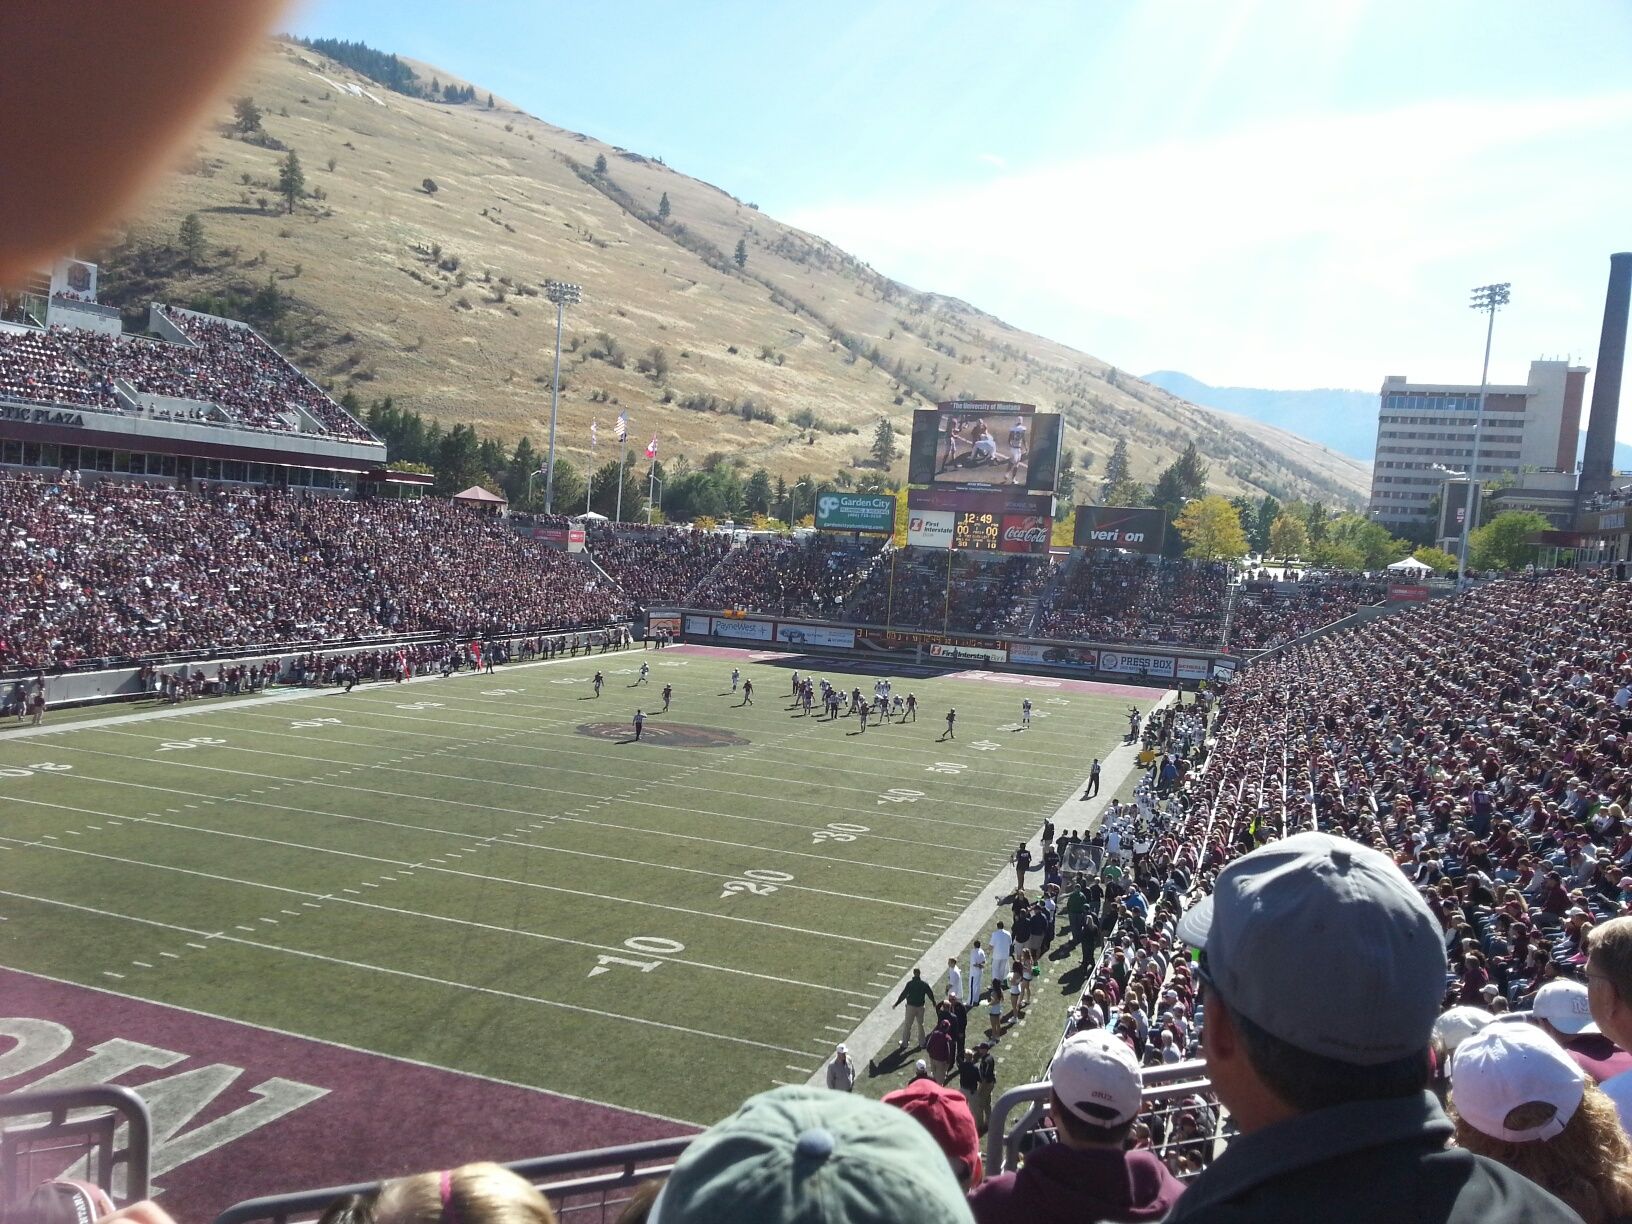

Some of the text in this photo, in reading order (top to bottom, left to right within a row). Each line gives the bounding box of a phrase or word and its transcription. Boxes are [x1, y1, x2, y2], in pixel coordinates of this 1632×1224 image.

[963, 403, 989, 411] University
[33, 409, 84, 426] PLAZA
[841, 497, 890, 509] Garden City
[964, 513, 992, 523] 12:49
[924, 525, 953, 533] Interstate
[957, 525, 998, 536] 00 00
[1090, 529, 1144, 542] verizon
[716, 620, 757, 633] PayneWest
[856, 628, 868, 638] 31
[996, 640, 1007, 650] 31
[1120, 656, 1151, 668] PRESS
[1153, 659, 1172, 670] BOX
[929, 761, 968, 775] 50
[886, 788, 925, 803] 40
[812, 823, 871, 843] 30
[723, 869, 794, 896] 20
[597, 936, 685, 973] 10
